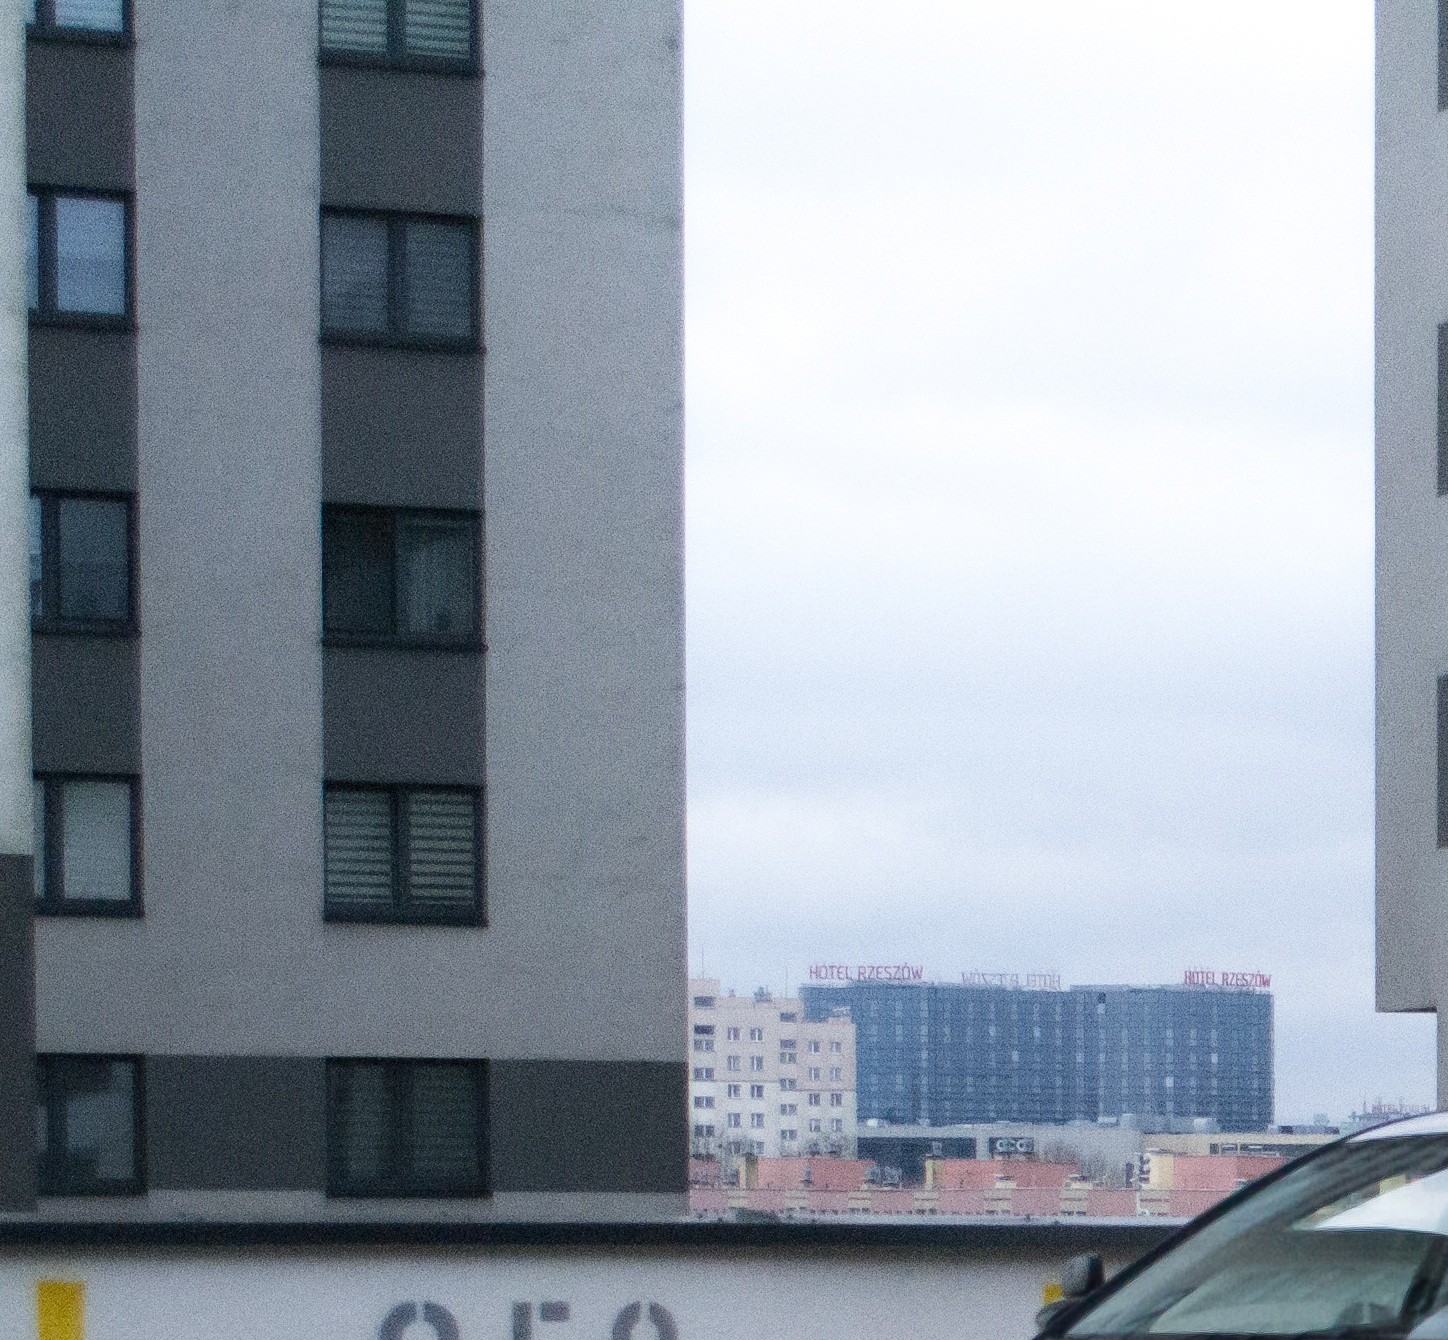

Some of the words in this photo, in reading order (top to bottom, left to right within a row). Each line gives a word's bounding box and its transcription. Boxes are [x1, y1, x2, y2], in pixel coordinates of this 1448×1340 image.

[809, 965, 850, 980] HOTEL
[857, 962, 924, 981] RZESZÓW
[1184, 970, 1214, 986] HOTEL
[1222, 970, 1271, 987] RZESZÓW
